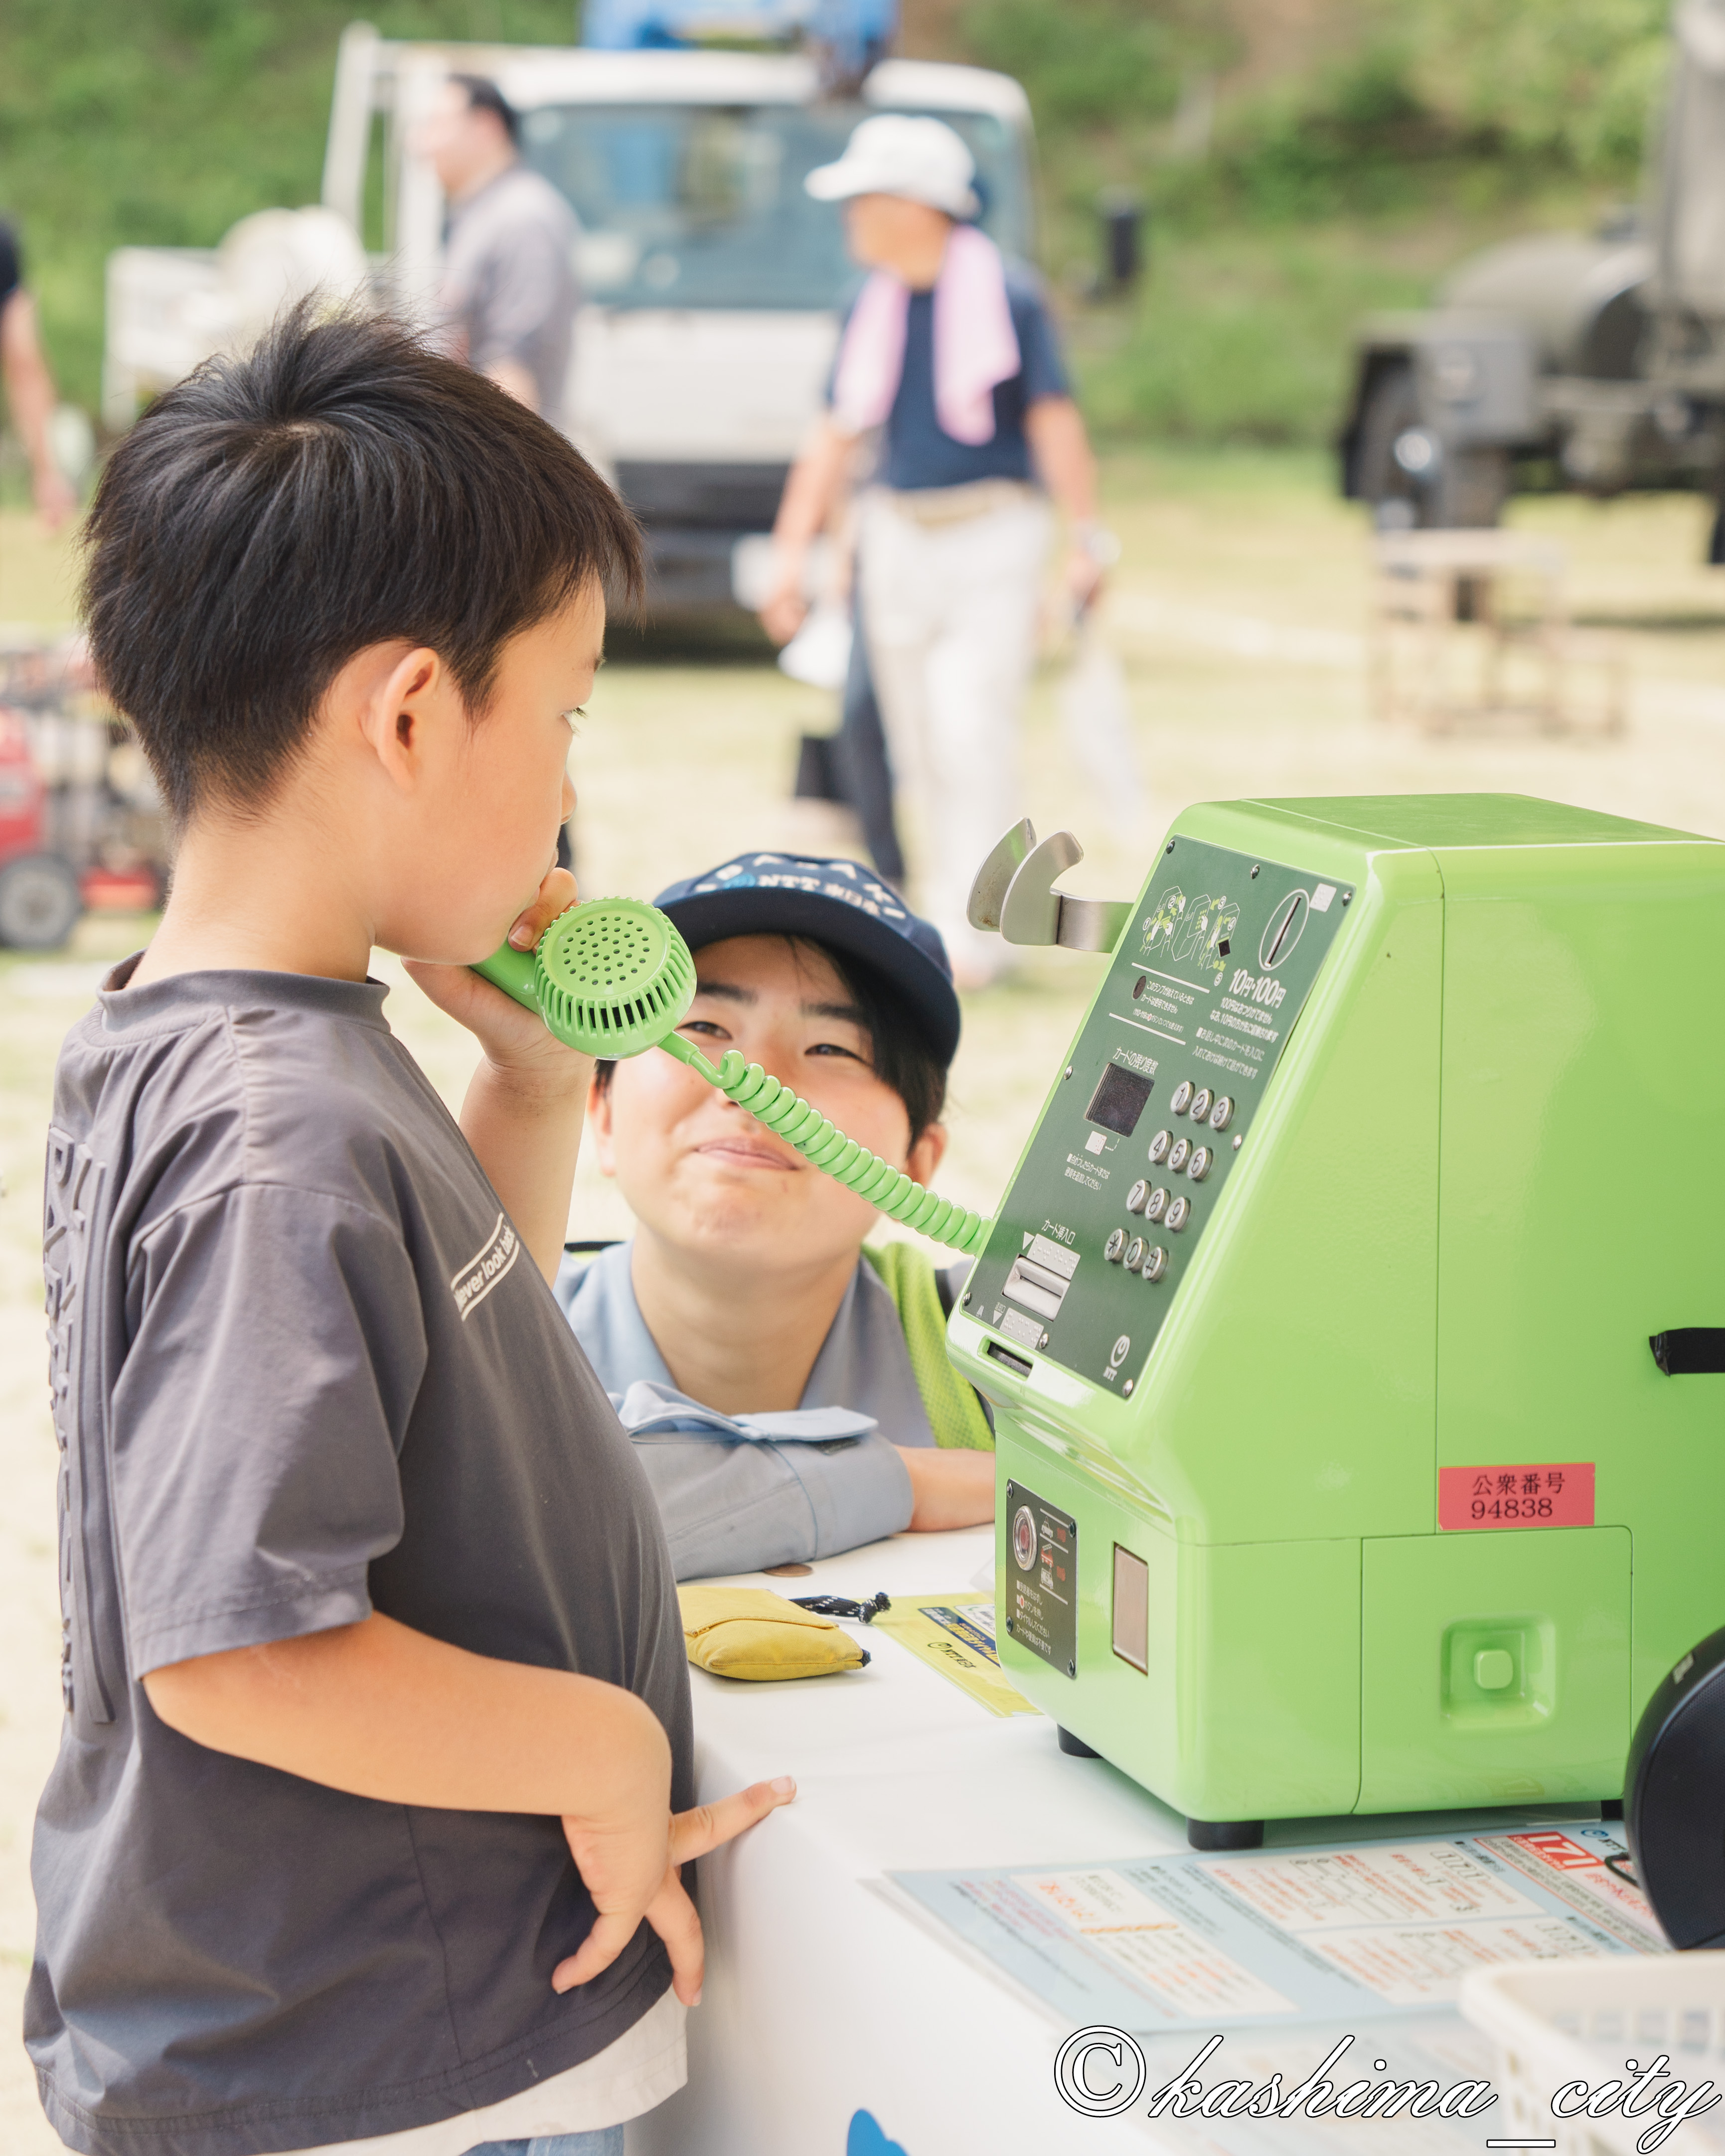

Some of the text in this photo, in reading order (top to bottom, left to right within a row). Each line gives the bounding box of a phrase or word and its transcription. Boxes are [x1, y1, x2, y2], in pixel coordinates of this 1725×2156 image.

[1113, 1046, 1159, 1076] カードの残り度数
[1041, 1219, 1076, 1245] カード挿入口
[481, 1246, 507, 1280] look
[1472, 1472, 1566, 1495] 公衆番号
[1471, 1497, 1553, 1520] 94838
